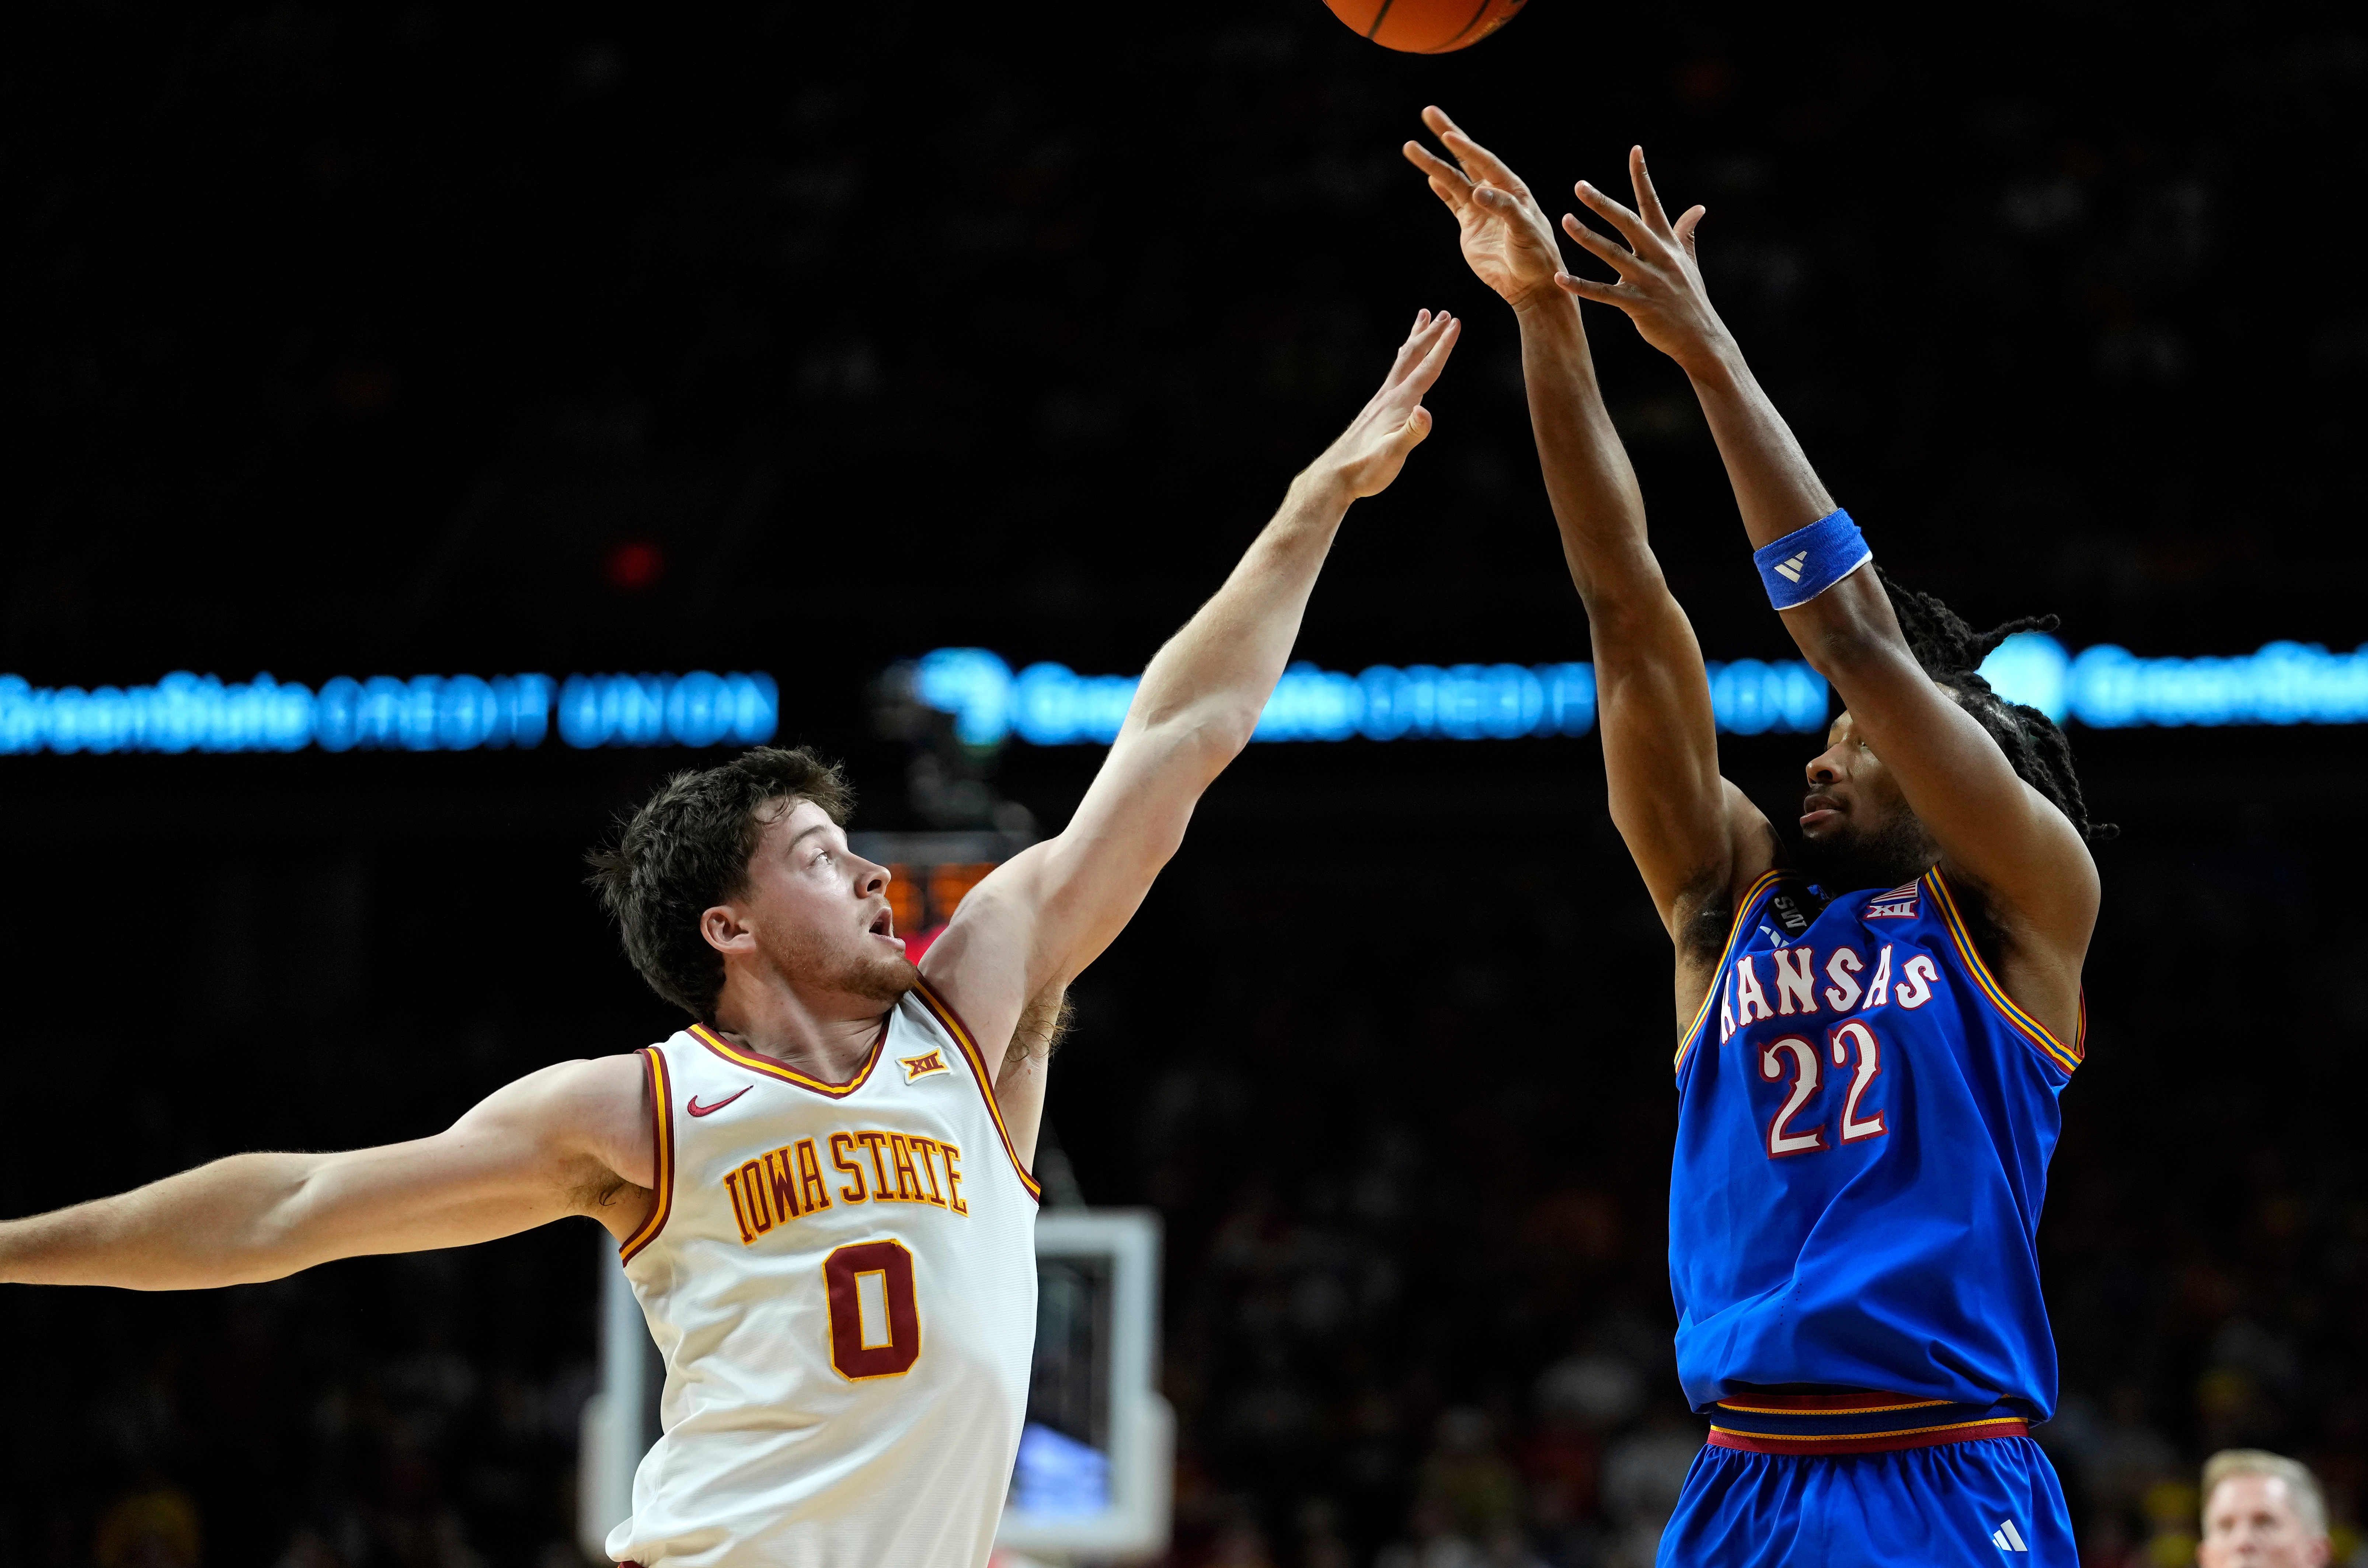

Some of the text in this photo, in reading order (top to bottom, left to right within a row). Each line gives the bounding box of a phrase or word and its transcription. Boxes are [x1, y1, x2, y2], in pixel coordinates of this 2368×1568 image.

[1720, 943, 1940, 1045] KANSAS
[904, 1052, 944, 1077] XII
[1758, 1018, 1888, 1159] 22
[723, 1129, 969, 1245] IOWA STATE
[822, 1238, 921, 1382] 0
